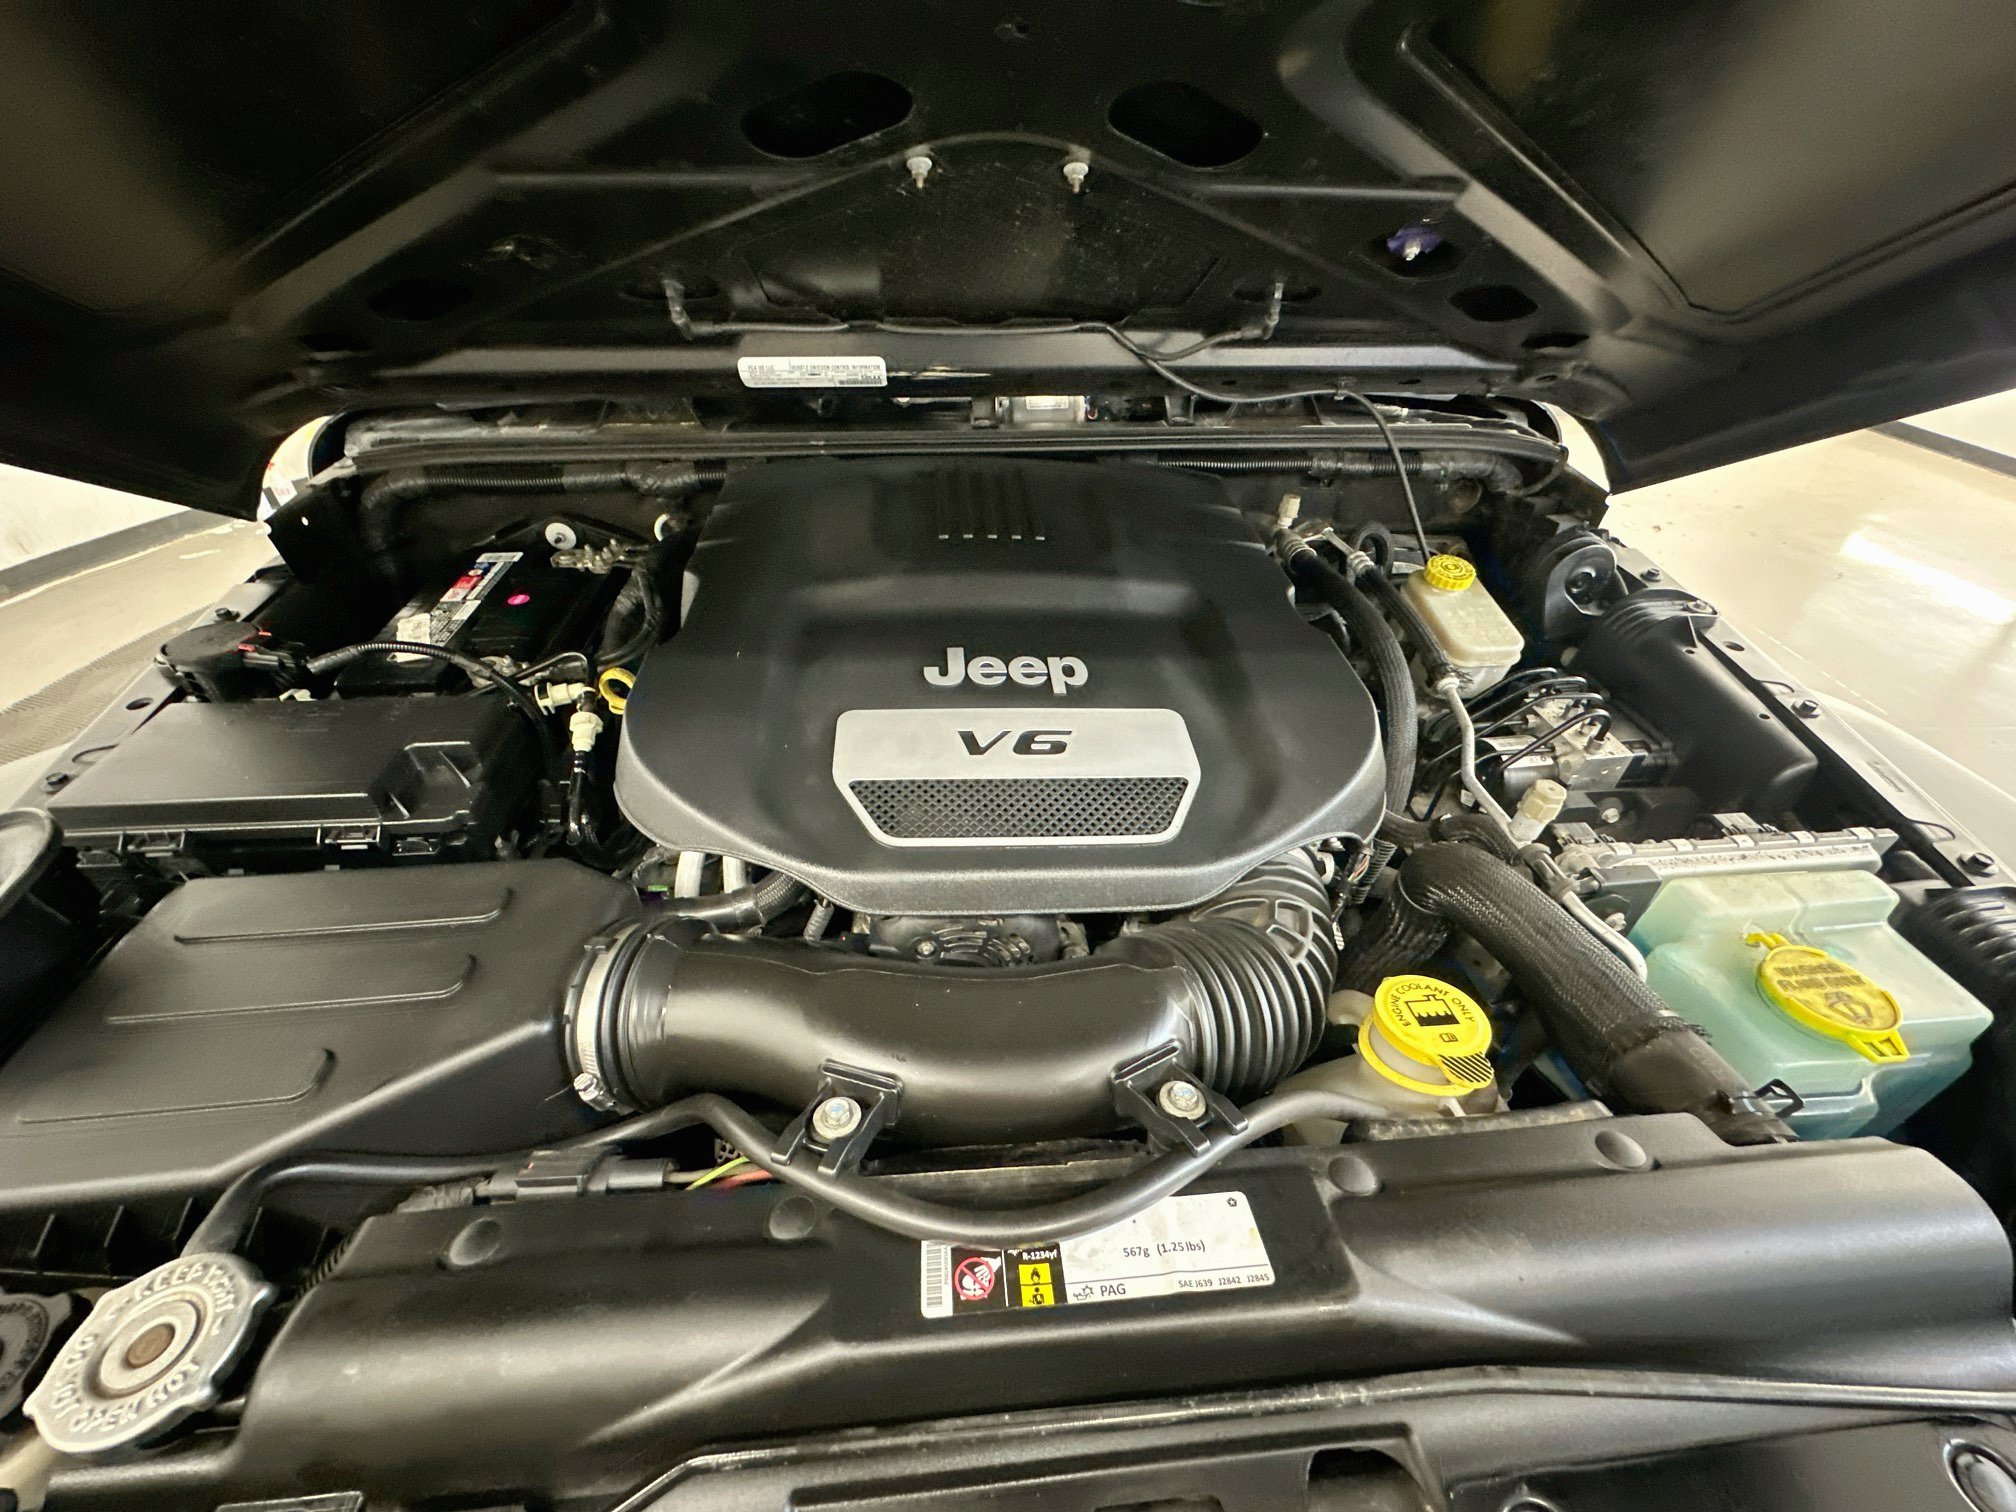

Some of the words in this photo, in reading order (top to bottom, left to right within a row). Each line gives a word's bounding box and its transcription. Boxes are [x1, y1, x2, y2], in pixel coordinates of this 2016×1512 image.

[923, 647, 1089, 695] Jeep
[957, 730, 1073, 756] V6
[1395, 982, 1450, 996] COOLANT
[1824, 974, 1866, 988] ONLY
[1390, 993, 1411, 1027] ENGINE
[1451, 997, 1476, 1023] ONLY
[1022, 1249, 1058, 1261] R-1234yf
[1122, 1246, 1150, 1258] 567g
[135, 1261, 205, 1301] KEEP
[1100, 1283, 1126, 1297] PAG
[1178, 1279, 1193, 1288] SAE
[1195, 1277, 1213, 1287] J639
[1218, 1275, 1242, 1286] J2842
[1246, 1273, 1270, 1284] J2845
[70, 1400, 142, 1431] OPEN
[146, 1356, 201, 1408] HOT
